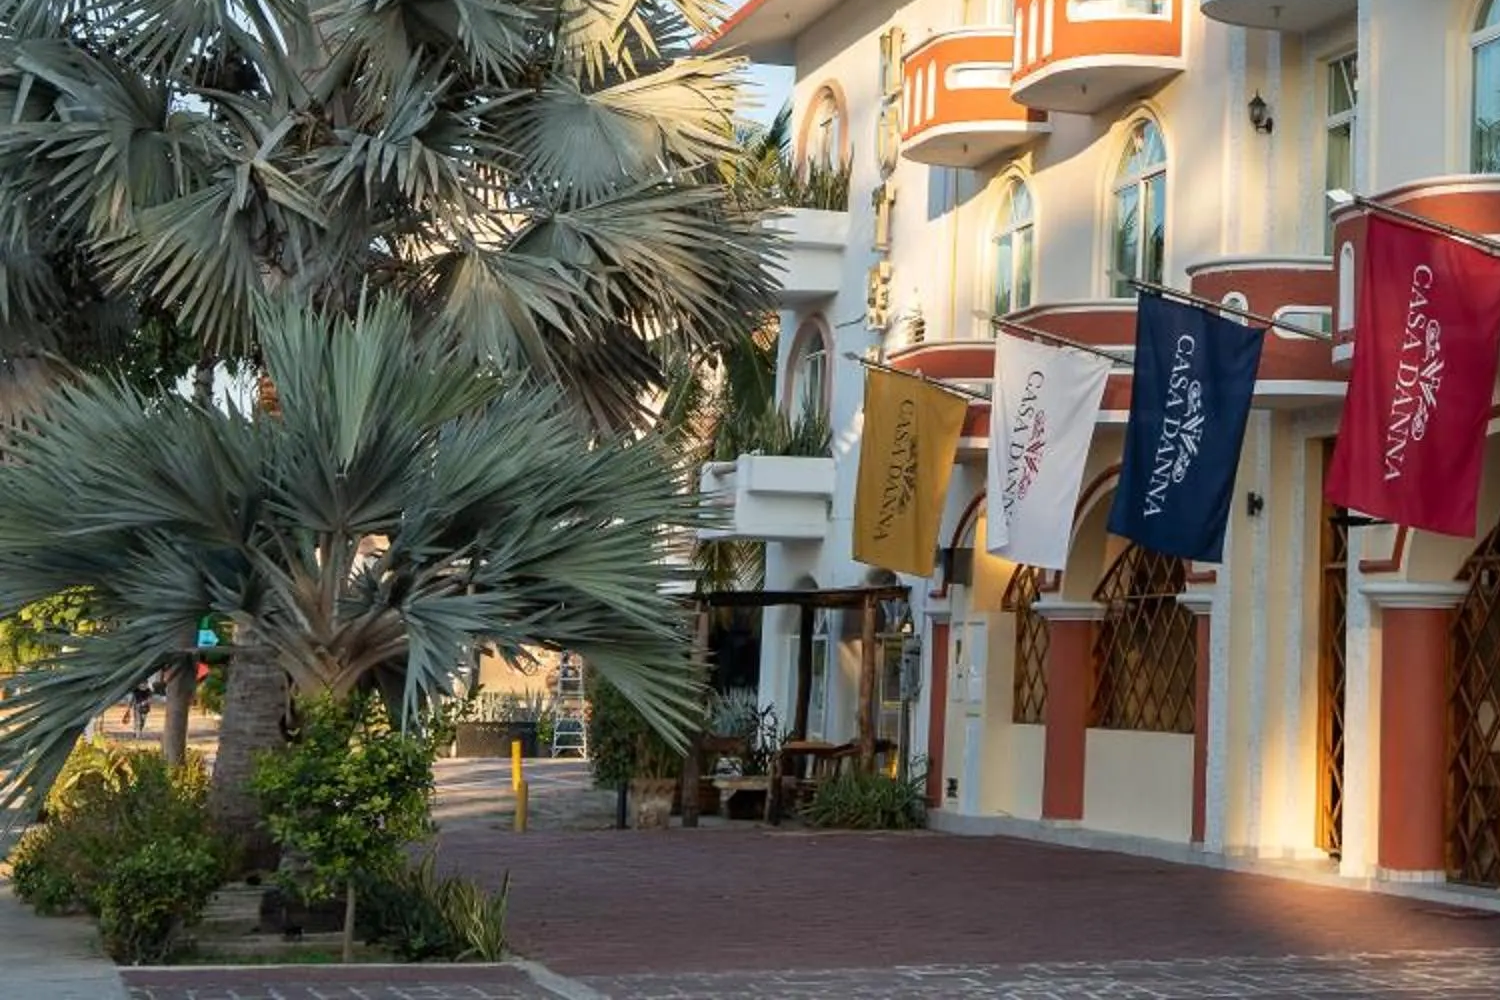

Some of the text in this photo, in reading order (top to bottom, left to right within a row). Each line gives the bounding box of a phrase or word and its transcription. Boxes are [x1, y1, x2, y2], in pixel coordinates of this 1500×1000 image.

[1013, 370, 1045, 433] CASA
[1143, 335, 1196, 518] CASA DANNA
[1384, 264, 1433, 481] CASA DANNA
[872, 399, 914, 541] CASA DANNA
